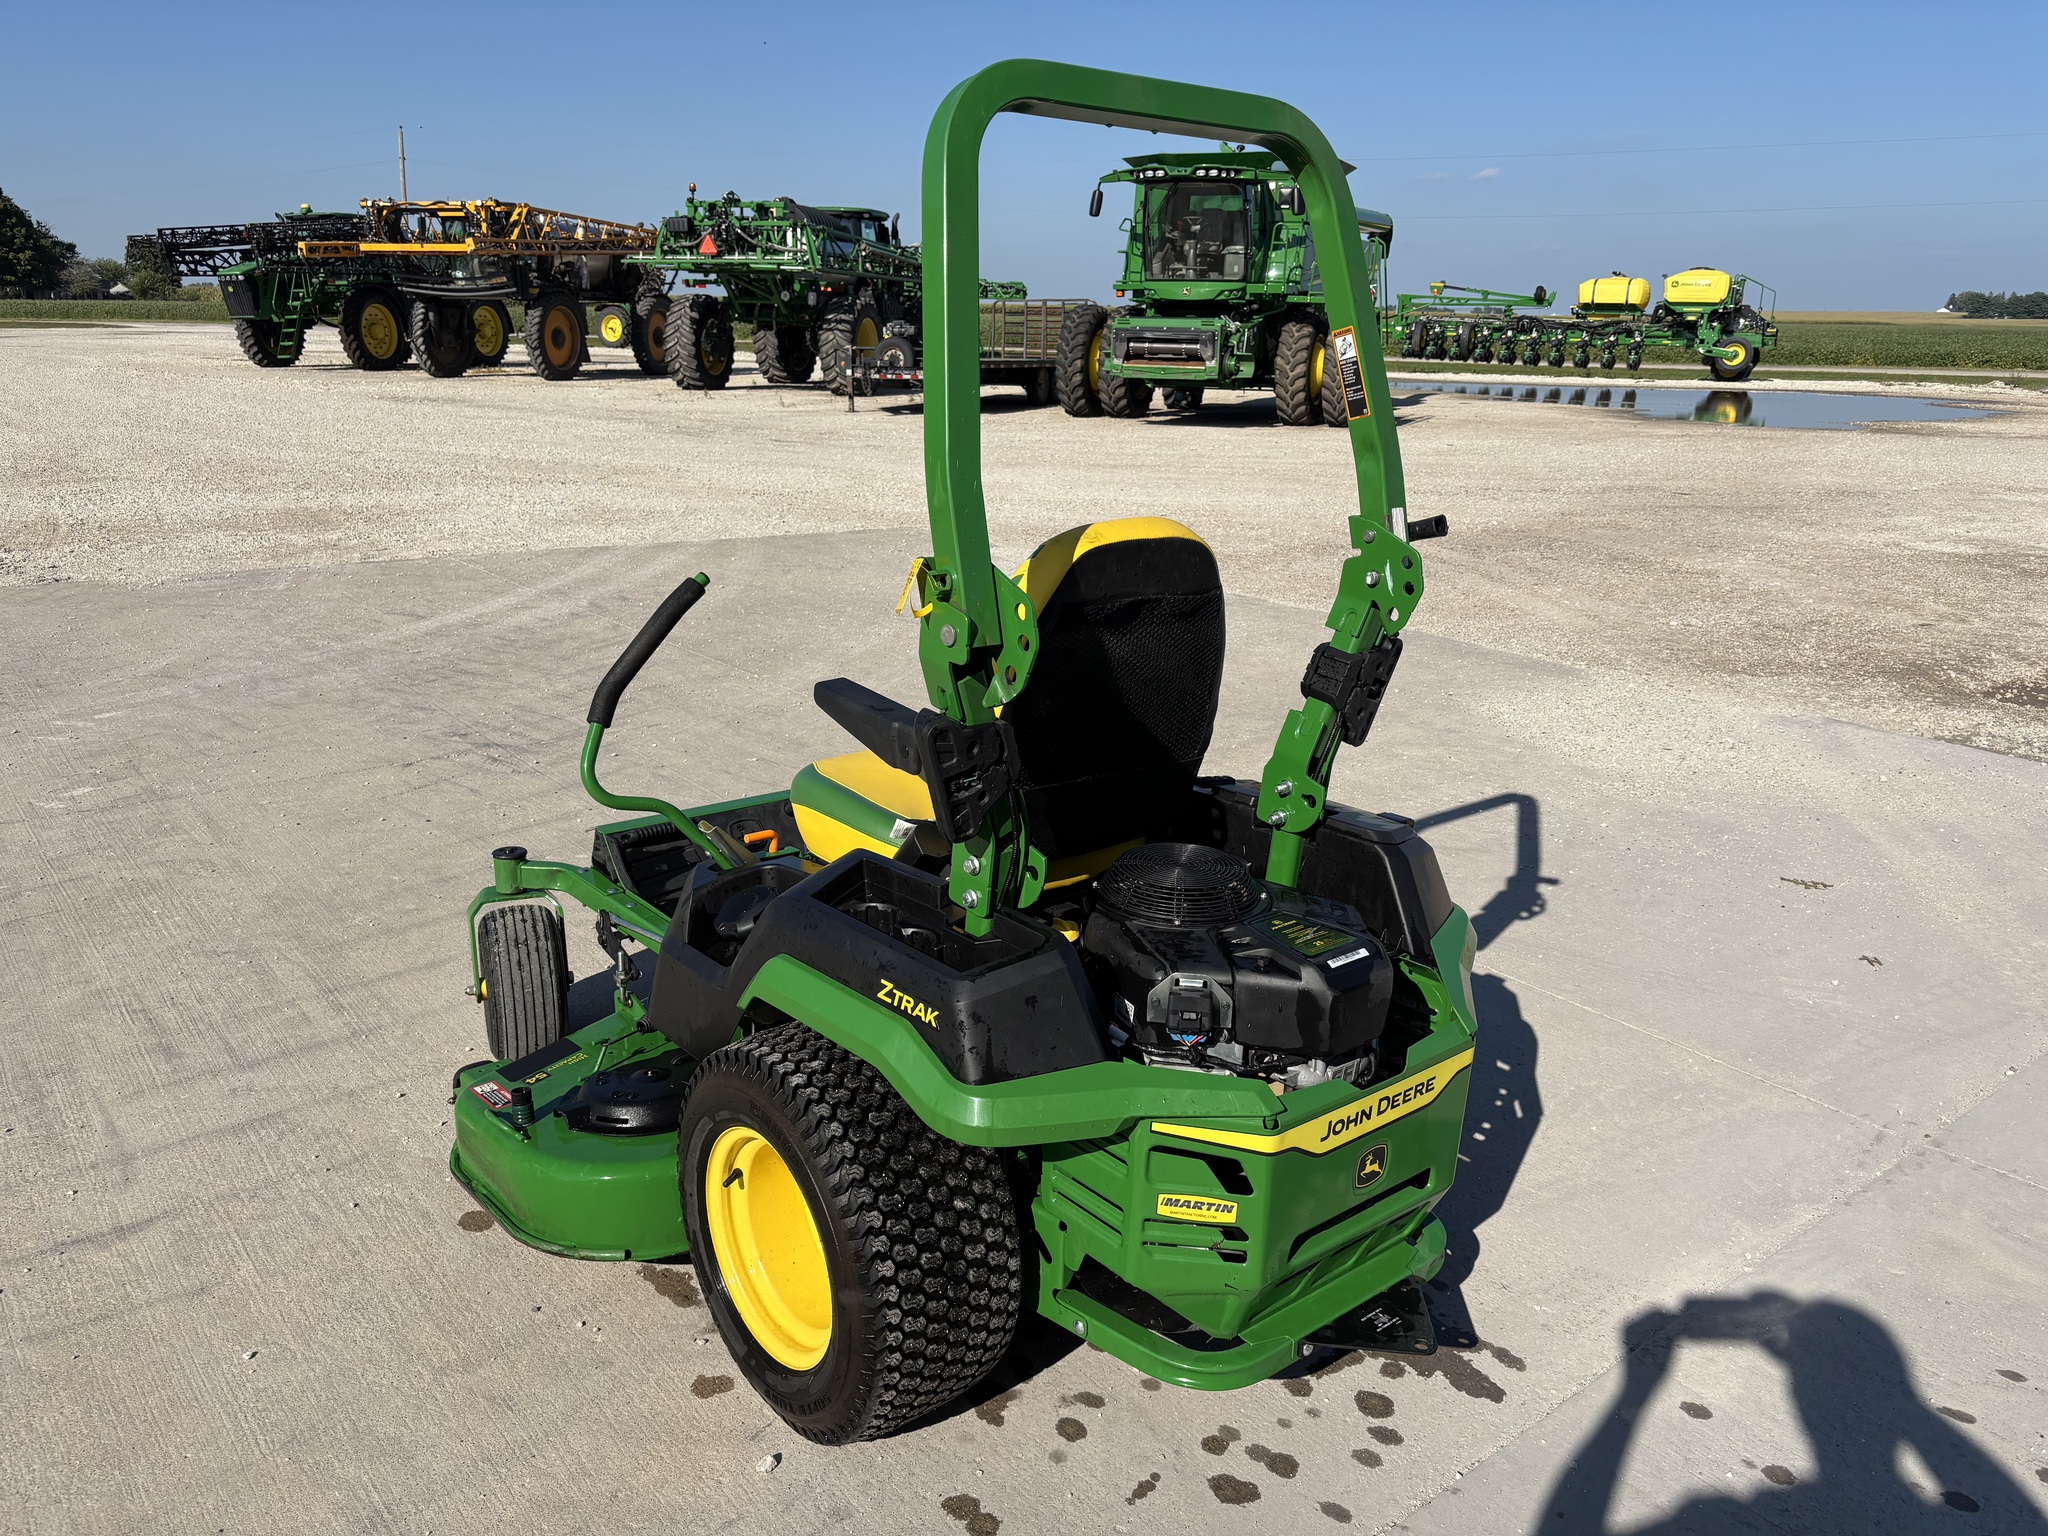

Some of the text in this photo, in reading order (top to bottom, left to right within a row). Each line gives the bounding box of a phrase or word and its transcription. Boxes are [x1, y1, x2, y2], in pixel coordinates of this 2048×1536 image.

[876, 978, 940, 1028] ZTRAK
[547, 1052, 584, 1071] CAPACITY
[525, 1072, 548, 1084] 54
[1319, 1075, 1437, 1143] JOHN DEERE
[1160, 1197, 1235, 1214] MARTIN
